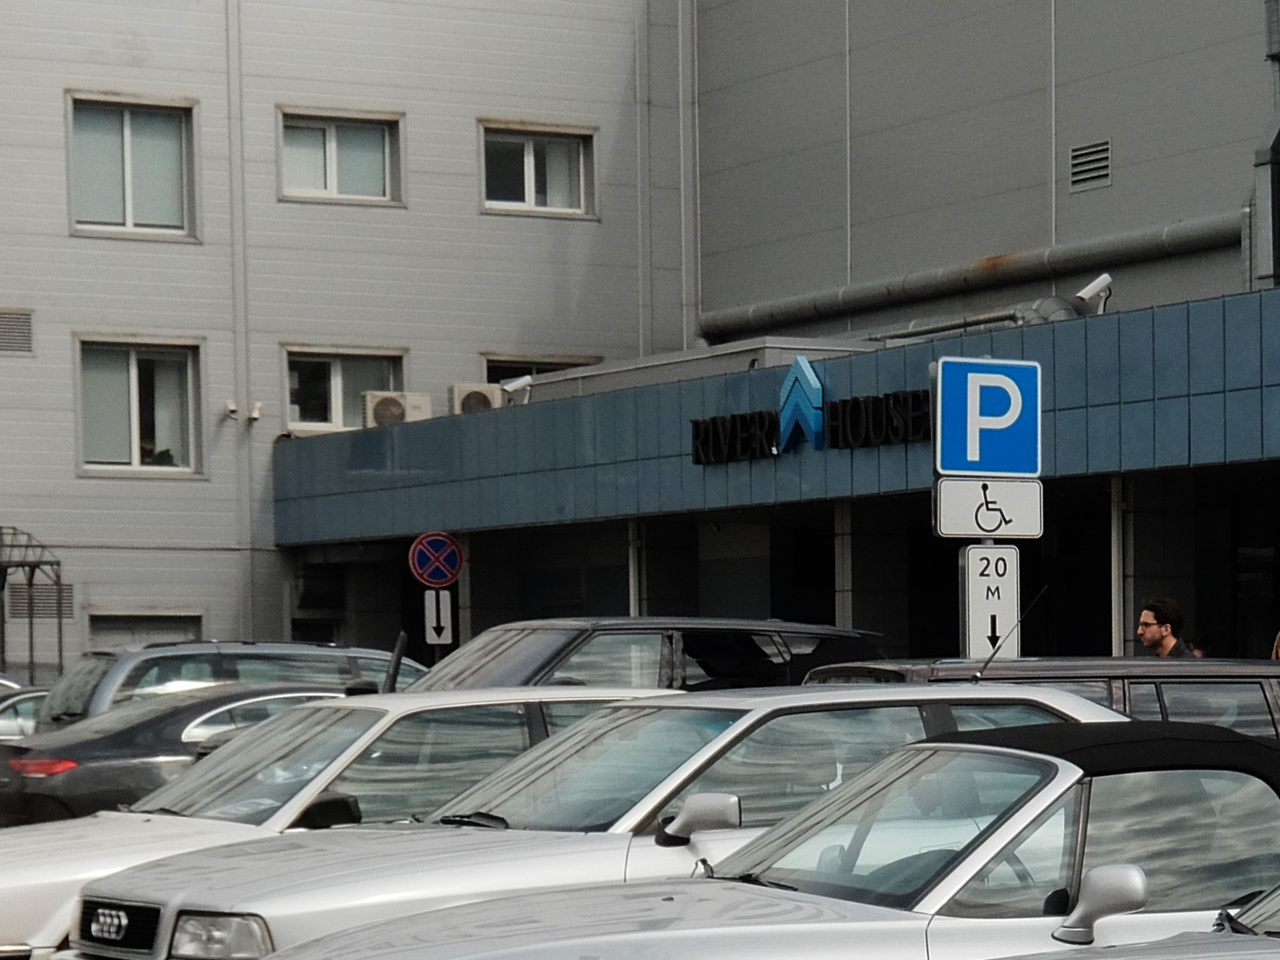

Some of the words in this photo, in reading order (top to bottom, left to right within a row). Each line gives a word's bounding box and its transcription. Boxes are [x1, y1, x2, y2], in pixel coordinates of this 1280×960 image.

[690, 409, 779, 465] RIVER
[827, 390, 931, 449] HOUSE
[967, 373, 1022, 461] P
[979, 556, 1007, 578] 20
